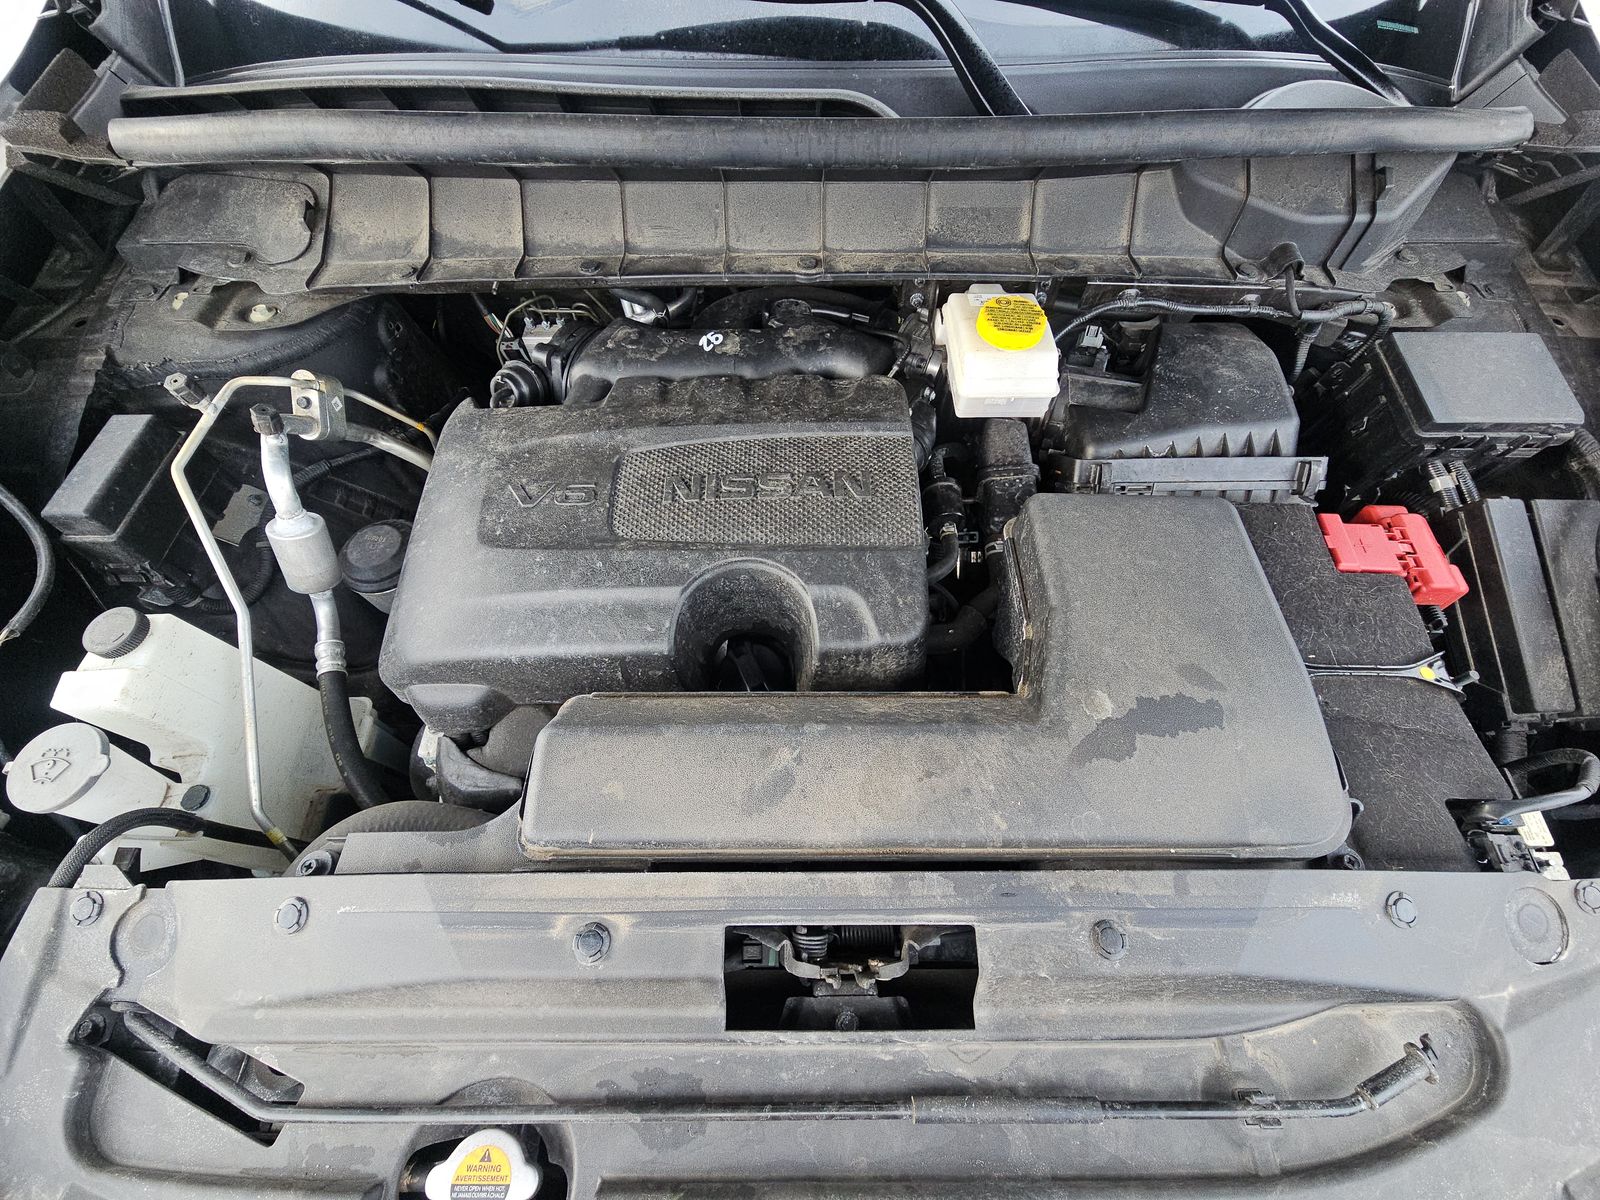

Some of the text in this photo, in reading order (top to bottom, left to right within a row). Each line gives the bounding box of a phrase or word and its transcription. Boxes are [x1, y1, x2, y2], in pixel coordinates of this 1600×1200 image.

[663, 471, 871, 502] NISSAN
[508, 483, 597, 507] V6
[466, 1164, 502, 1173] WARNING
[455, 1174, 508, 1182] AVERTISSEMENT
